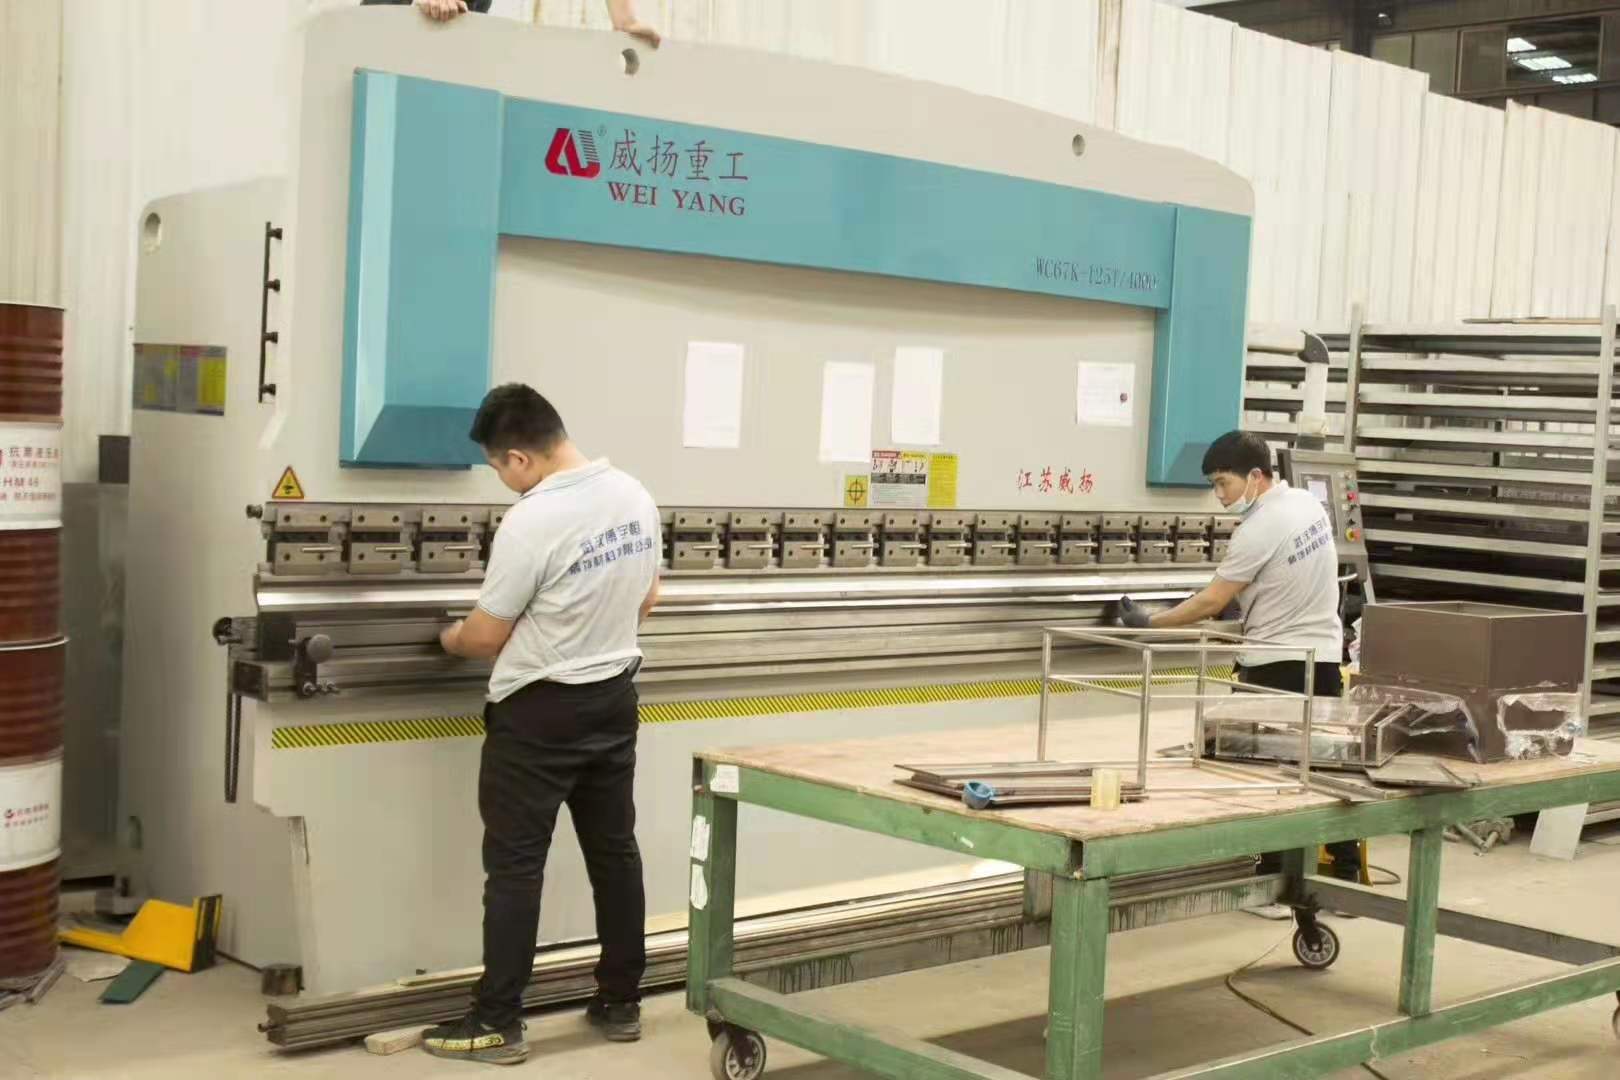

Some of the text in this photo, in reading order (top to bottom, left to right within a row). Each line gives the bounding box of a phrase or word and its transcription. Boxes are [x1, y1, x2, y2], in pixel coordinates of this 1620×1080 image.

[608, 128, 749, 181] 威扬重工
[607, 181, 745, 217] WEI YANG
[1016, 465, 1094, 494] 江苏威扬
